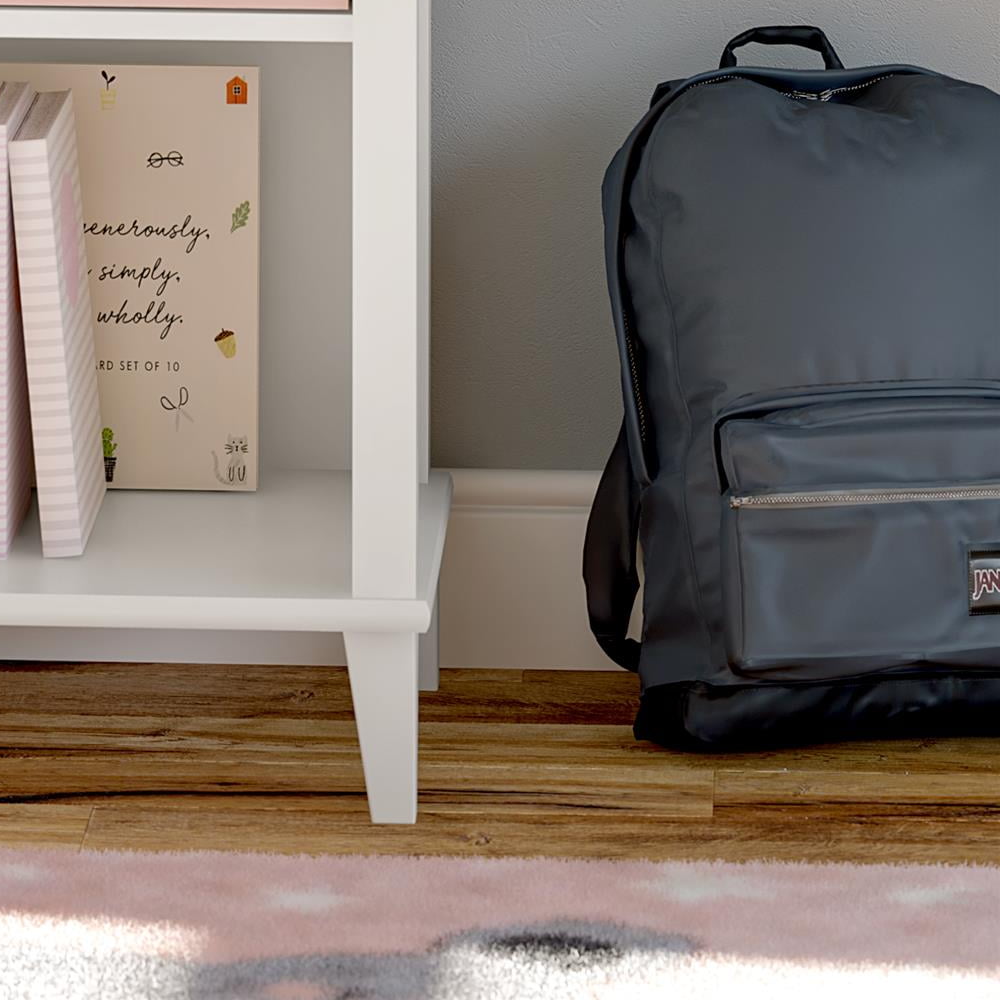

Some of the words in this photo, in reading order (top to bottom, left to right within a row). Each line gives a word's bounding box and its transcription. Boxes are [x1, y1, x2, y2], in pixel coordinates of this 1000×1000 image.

[82, 214, 210, 254] enerously,
[97, 299, 184, 340] wholly.
[95, 360, 114, 371] RD
[119, 360, 139, 371] SET
[144, 360, 160, 372] OF
[167, 361, 180, 372] 10
